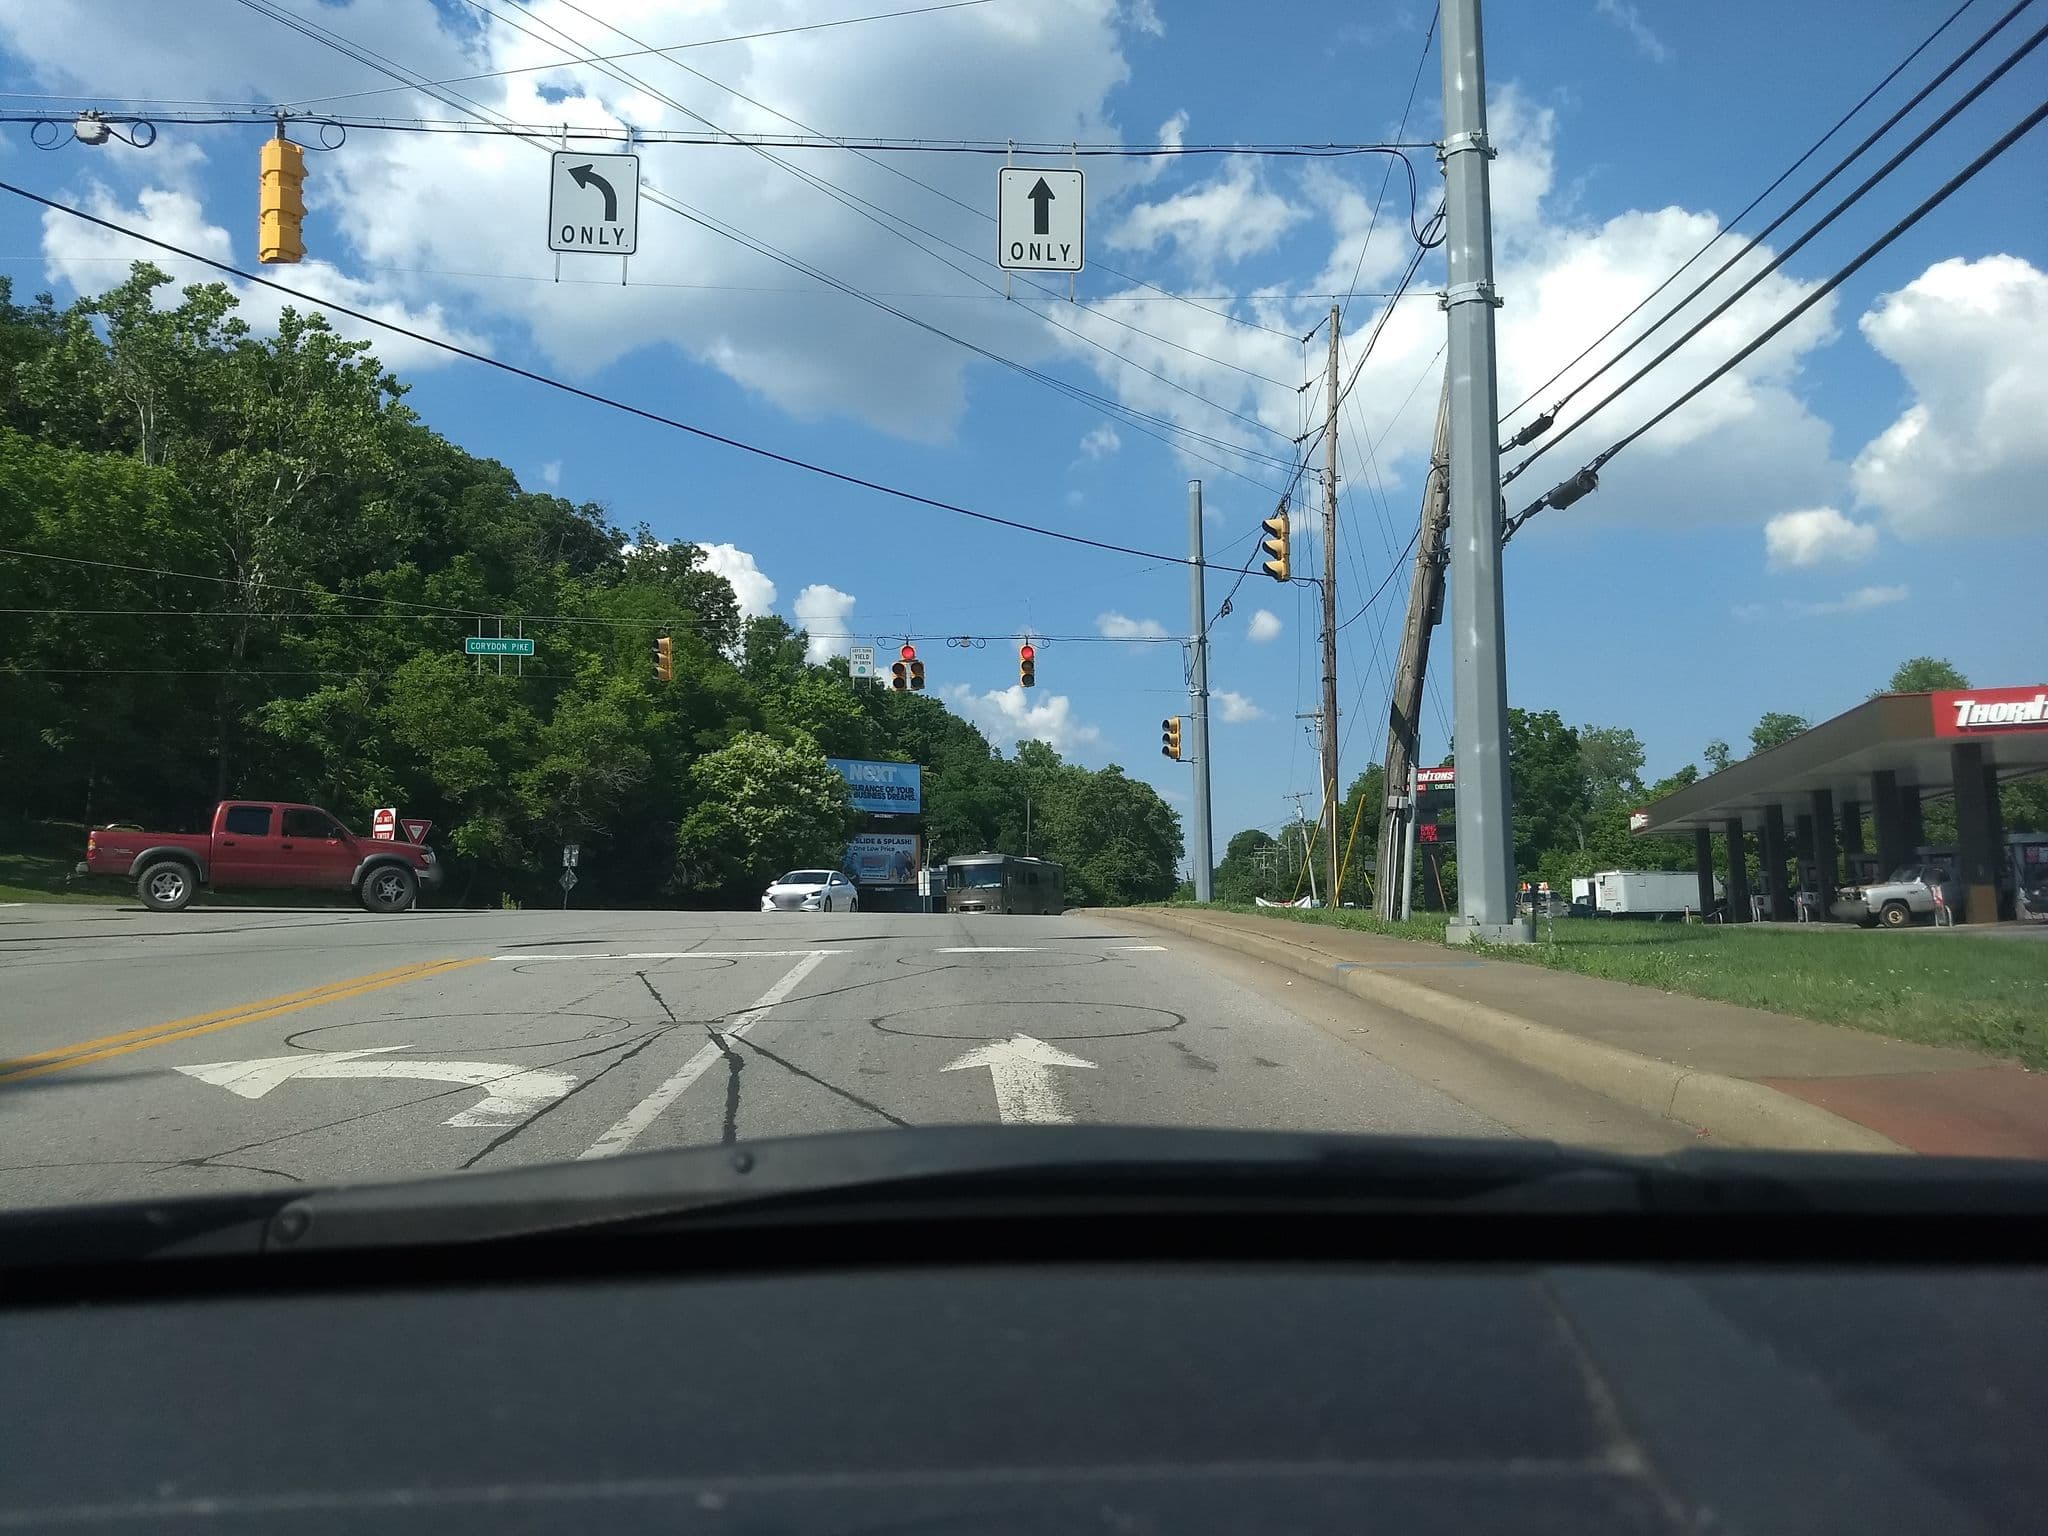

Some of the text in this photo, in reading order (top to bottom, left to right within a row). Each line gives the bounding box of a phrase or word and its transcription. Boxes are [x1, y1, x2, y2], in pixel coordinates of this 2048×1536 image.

[561, 225, 624, 246] ONLY
[1011, 242, 1071, 262] ONLY
[470, 642, 529, 651] CORYDON PIKE
[849, 764, 897, 782] NEXT
[853, 792, 886, 800] BUSINESS
[383, 815, 392, 823] NOT
